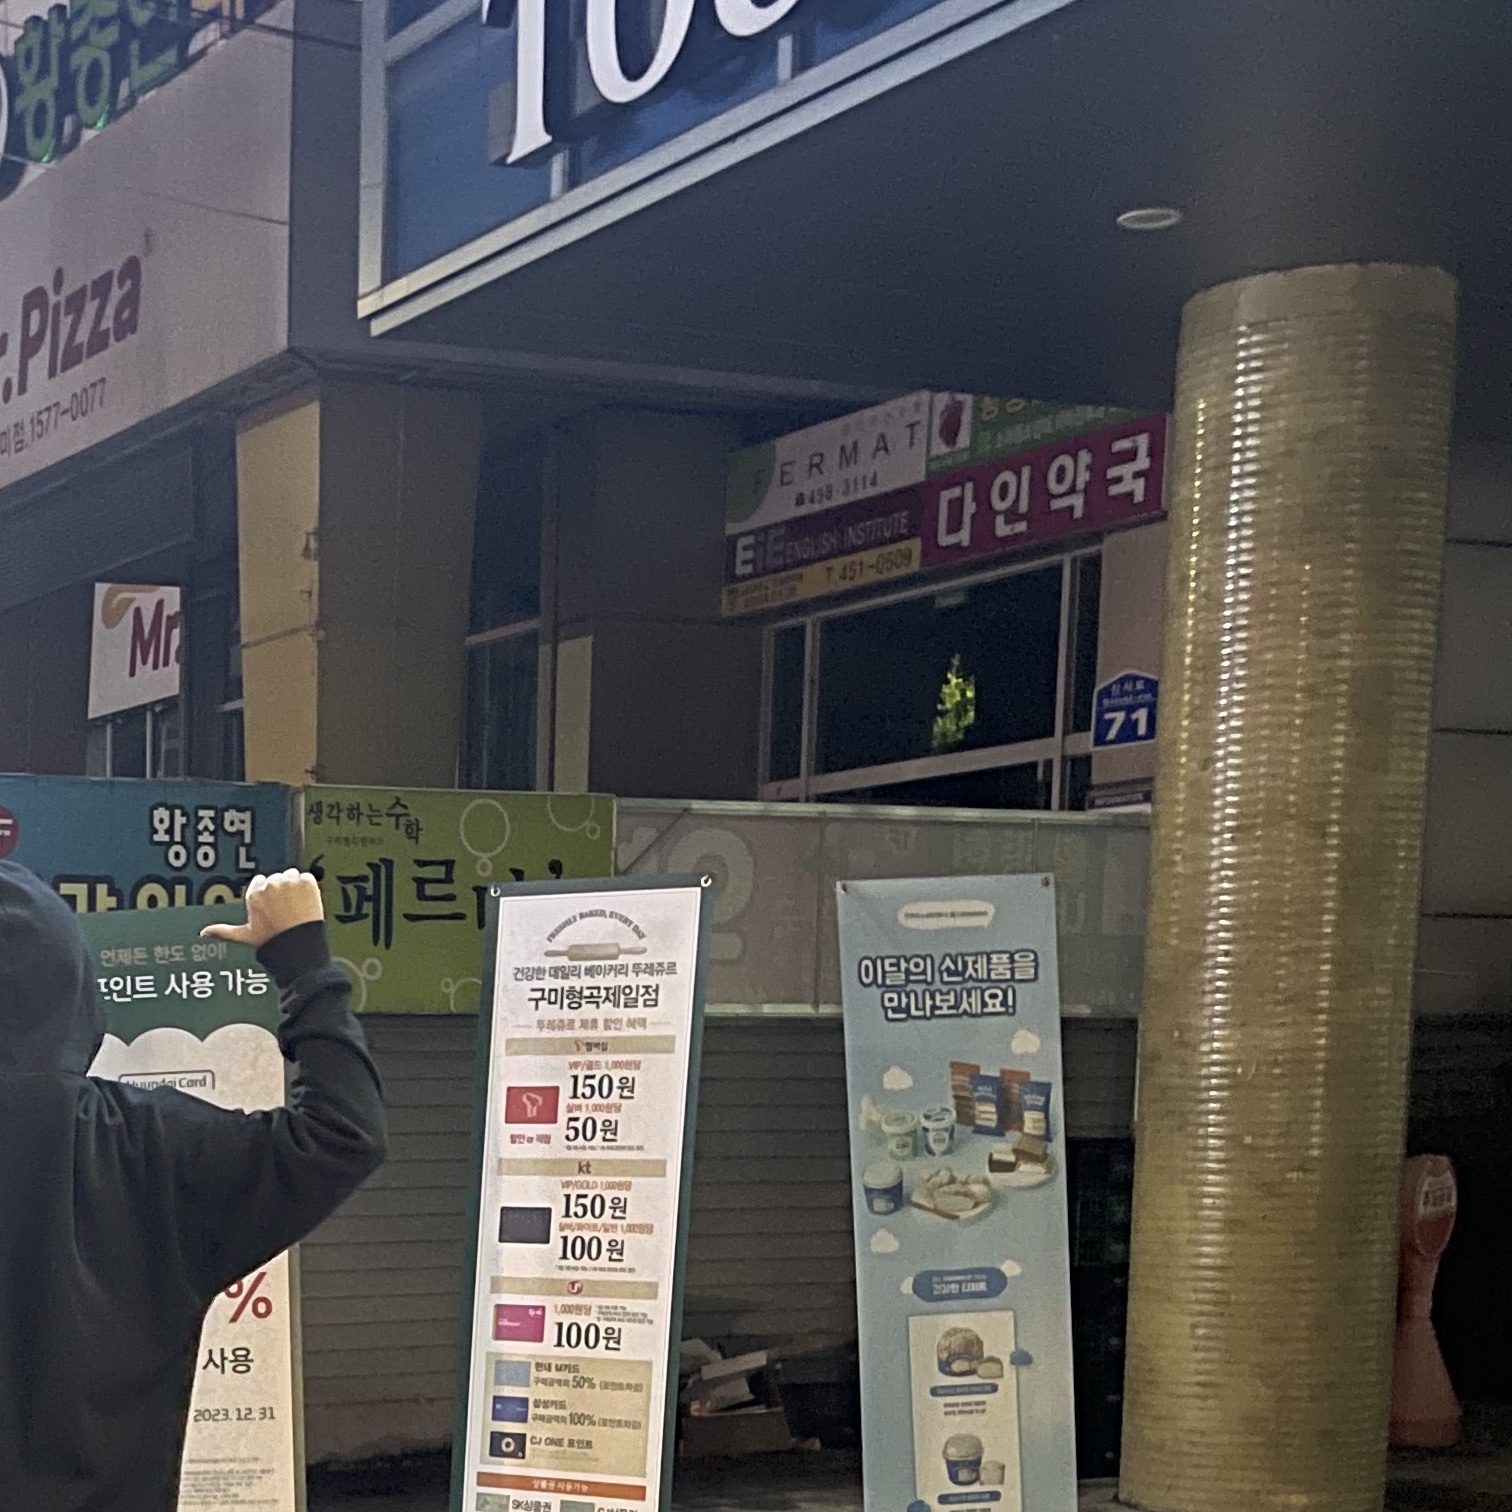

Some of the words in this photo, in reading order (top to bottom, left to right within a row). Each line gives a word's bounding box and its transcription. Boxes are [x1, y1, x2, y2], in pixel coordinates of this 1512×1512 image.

[937, 433, 1151, 547] 다인약국
[1104, 707, 1149, 741] 71
[100, 947, 149, 968] 언제든
[154, 945, 186, 965] 한도
[860, 955, 932, 986] 이달의
[940, 951, 1036, 982] 신제품을
[164, 971, 215, 999] 사용
[220, 968, 271, 996] 가능
[513, 966, 546, 981] 건강한
[549, 964, 581, 980] 데일리
[584, 963, 629, 979] 베이커리
[632, 961, 678, 977] 뚜레쥬르
[528, 983, 660, 1011] 구미형곡제일점
[882, 987, 1014, 1020] 만나보세요!
[178, 1076, 207, 1089] Card
[202, 1347, 254, 1375] 사용
[571, 1376, 596, 1389] 50%
[569, 1412, 596, 1427] 100%
[544, 1437, 564, 1447] ONE
